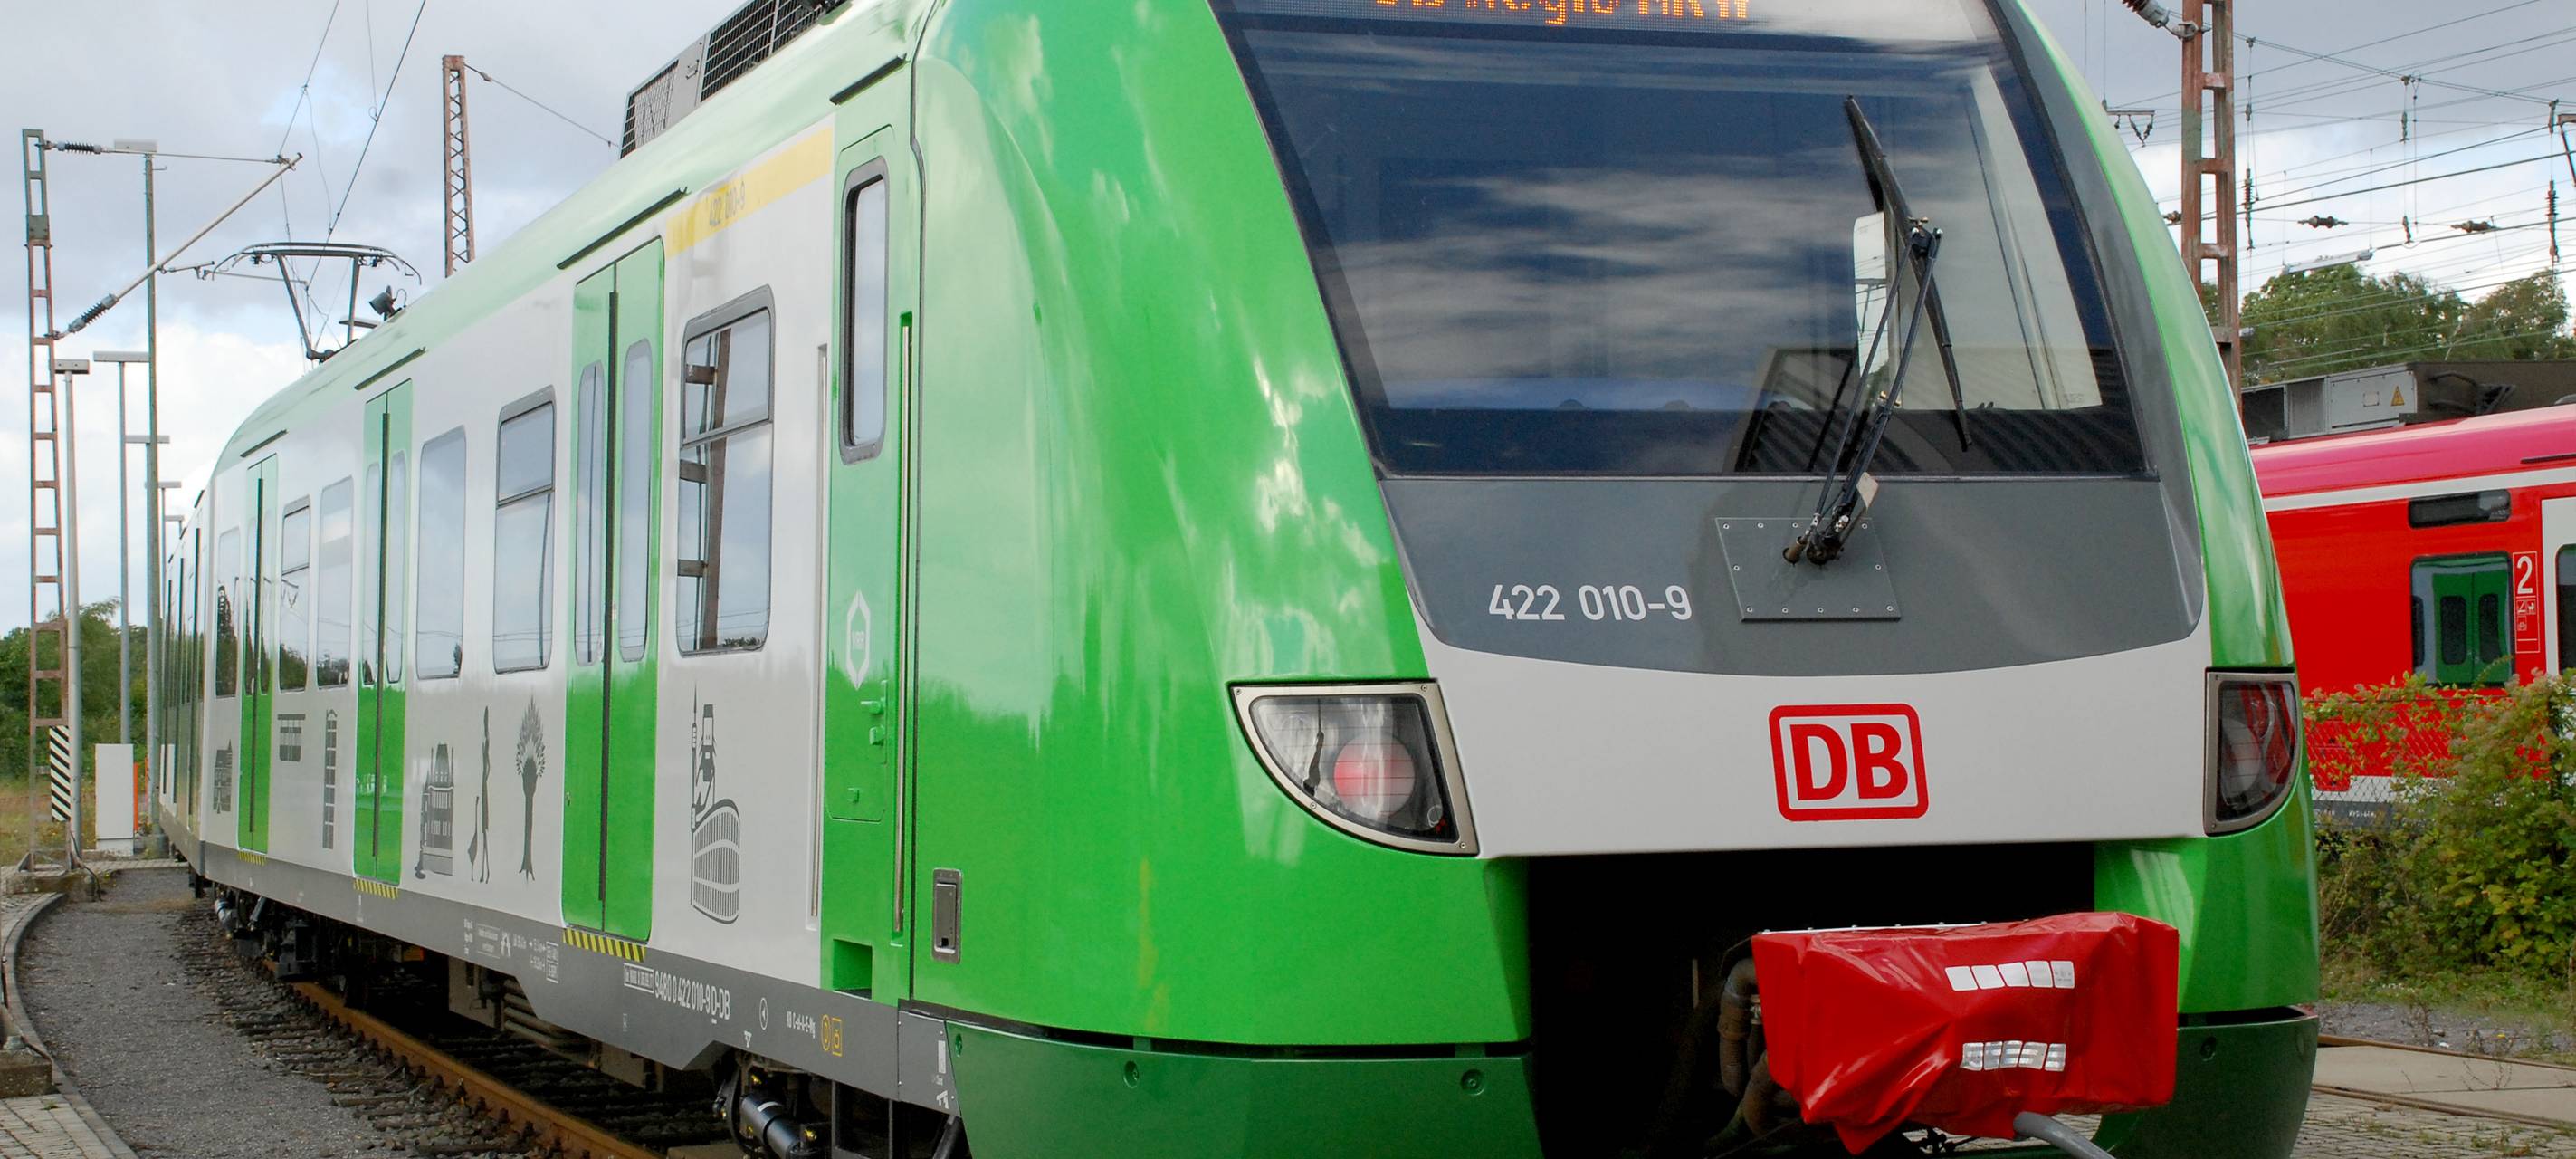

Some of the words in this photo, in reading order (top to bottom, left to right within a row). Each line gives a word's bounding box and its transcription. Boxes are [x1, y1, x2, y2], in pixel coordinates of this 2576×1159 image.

[2516, 555, 2533, 594] 2
[1489, 584, 1565, 620] 422
[1578, 585, 1693, 621] 010-9
[1789, 723, 1908, 800] DB
[711, 985, 730, 1020] D-DB
